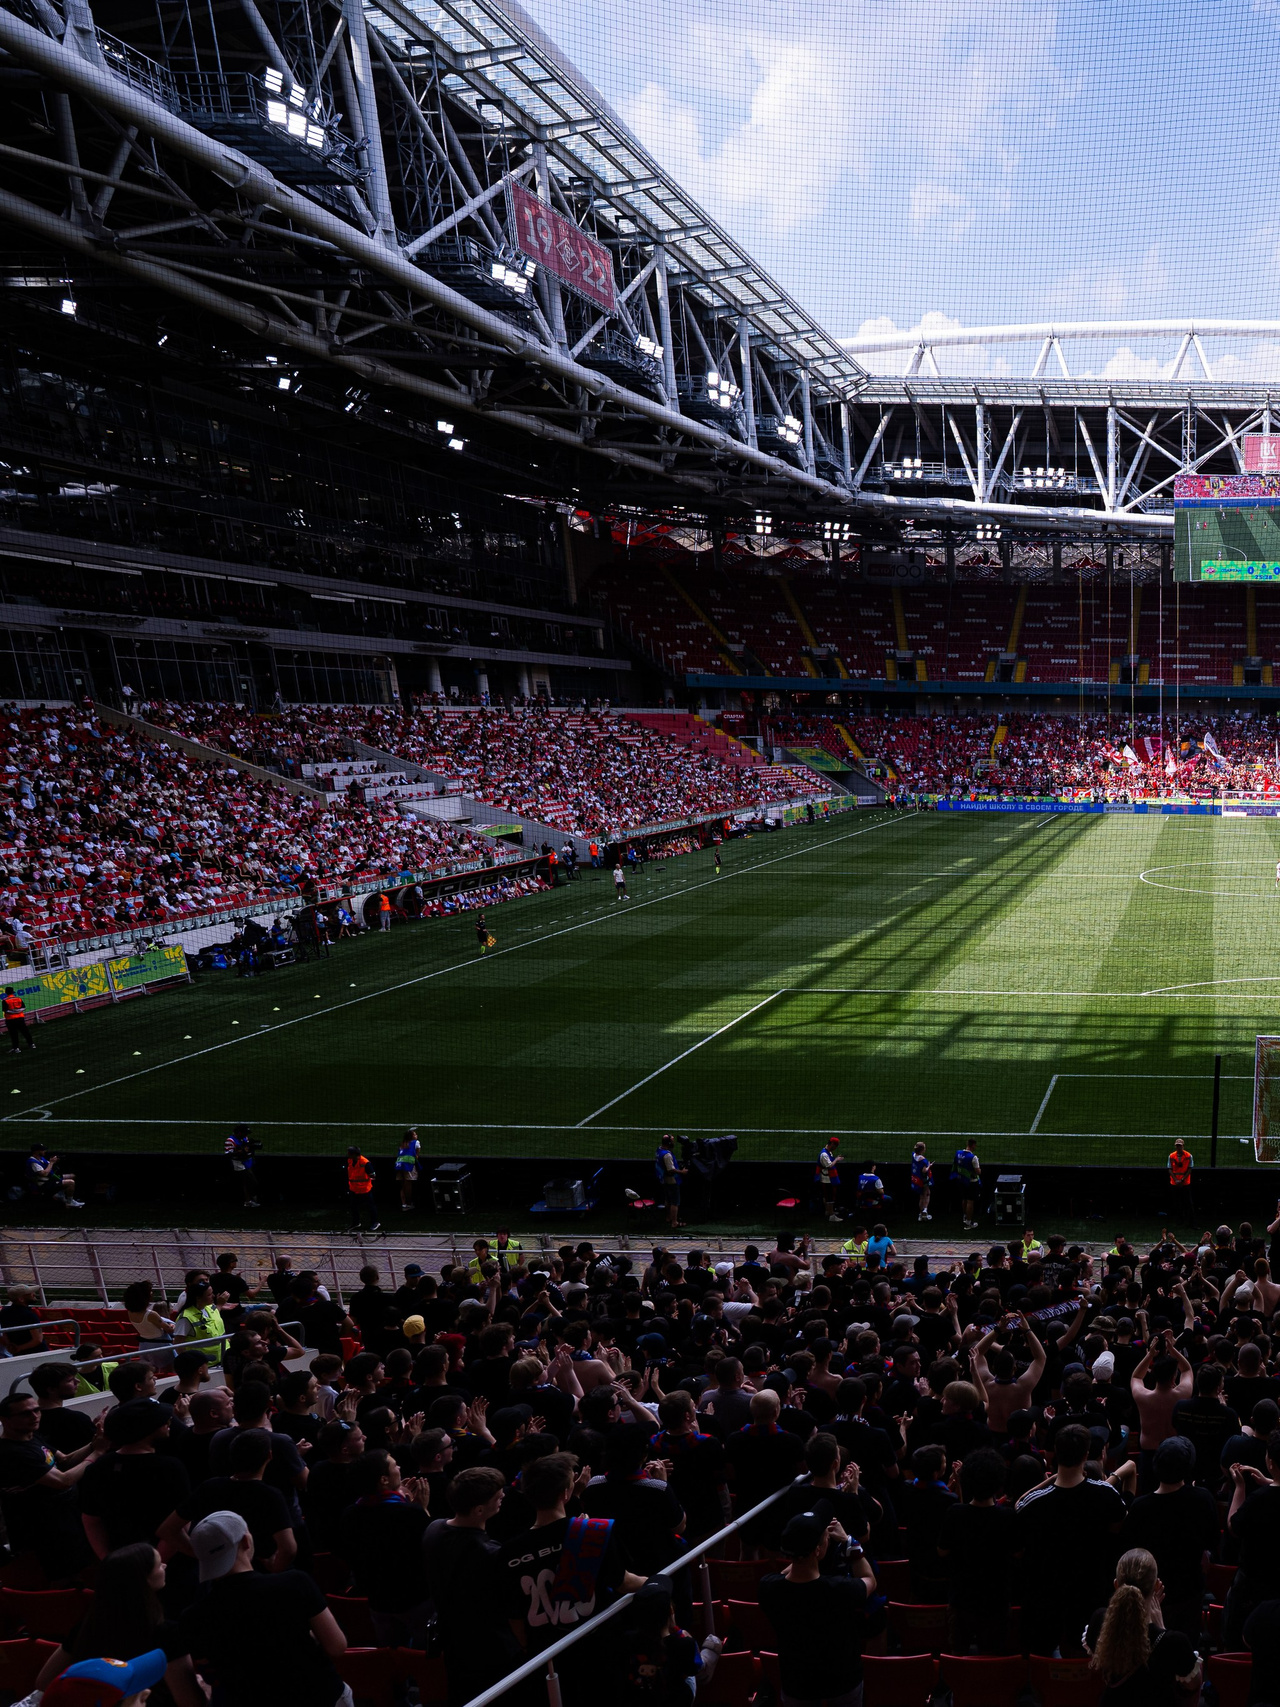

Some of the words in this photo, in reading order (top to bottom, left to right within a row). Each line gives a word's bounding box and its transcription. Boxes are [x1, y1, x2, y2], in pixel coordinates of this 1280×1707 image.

[523, 206, 553, 255] 19
[581, 249, 609, 297] 22
[1247, 566, 1254, 575] 0
[1273, 566, 1280, 575] 0
[508, 1553, 535, 1567] OG
[538, 1543, 563, 1558] BU
